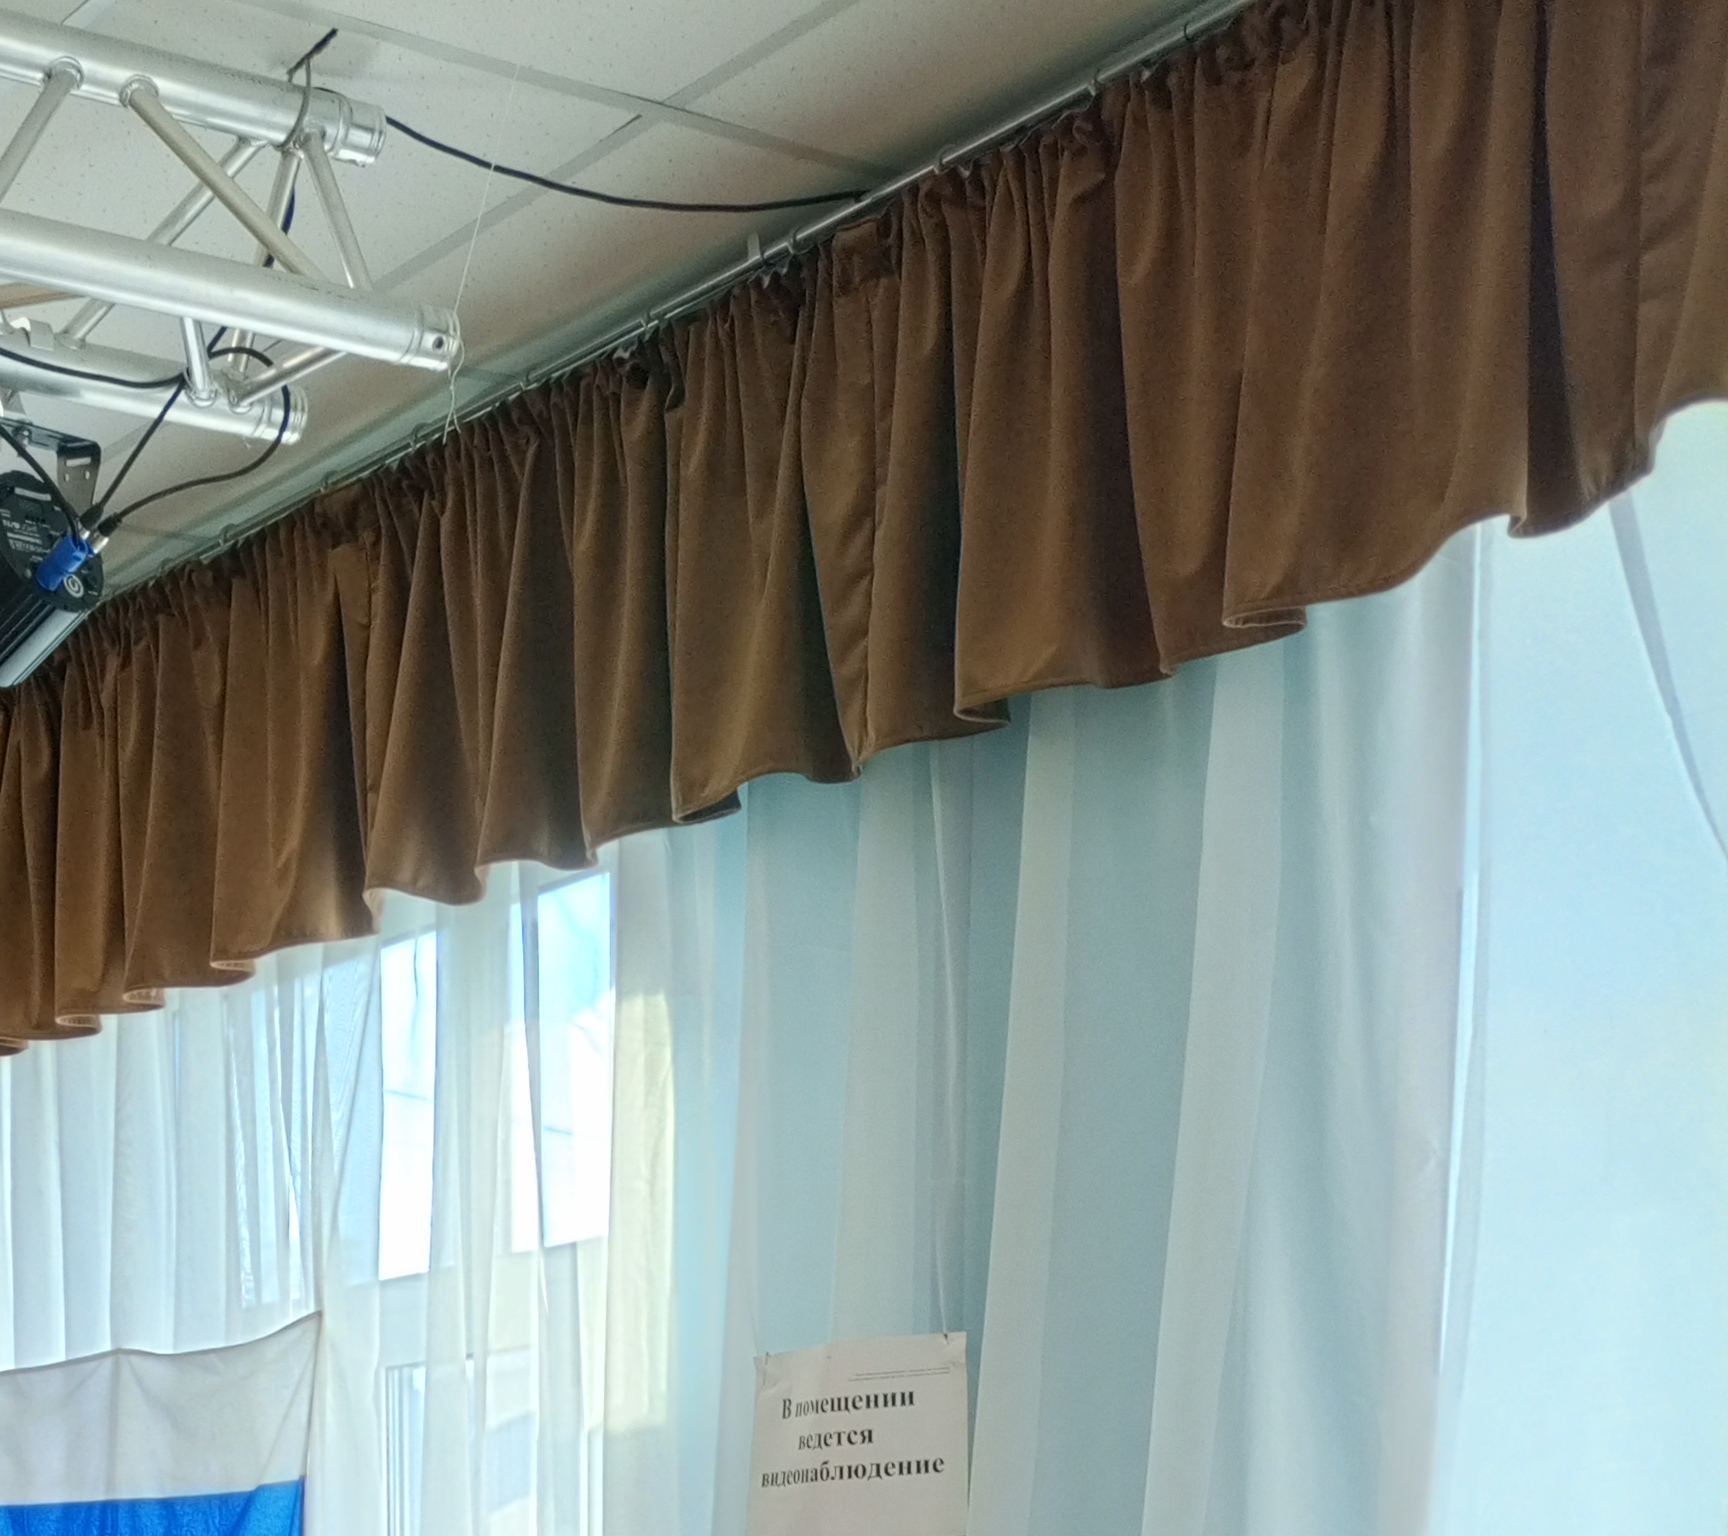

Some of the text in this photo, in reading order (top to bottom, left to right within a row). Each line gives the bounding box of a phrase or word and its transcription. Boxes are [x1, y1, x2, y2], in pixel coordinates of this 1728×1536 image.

[781, 1389, 915, 1420] В помещении
[798, 1427, 874, 1451] ведется
[761, 1456, 945, 1489] видеонаблюдение
